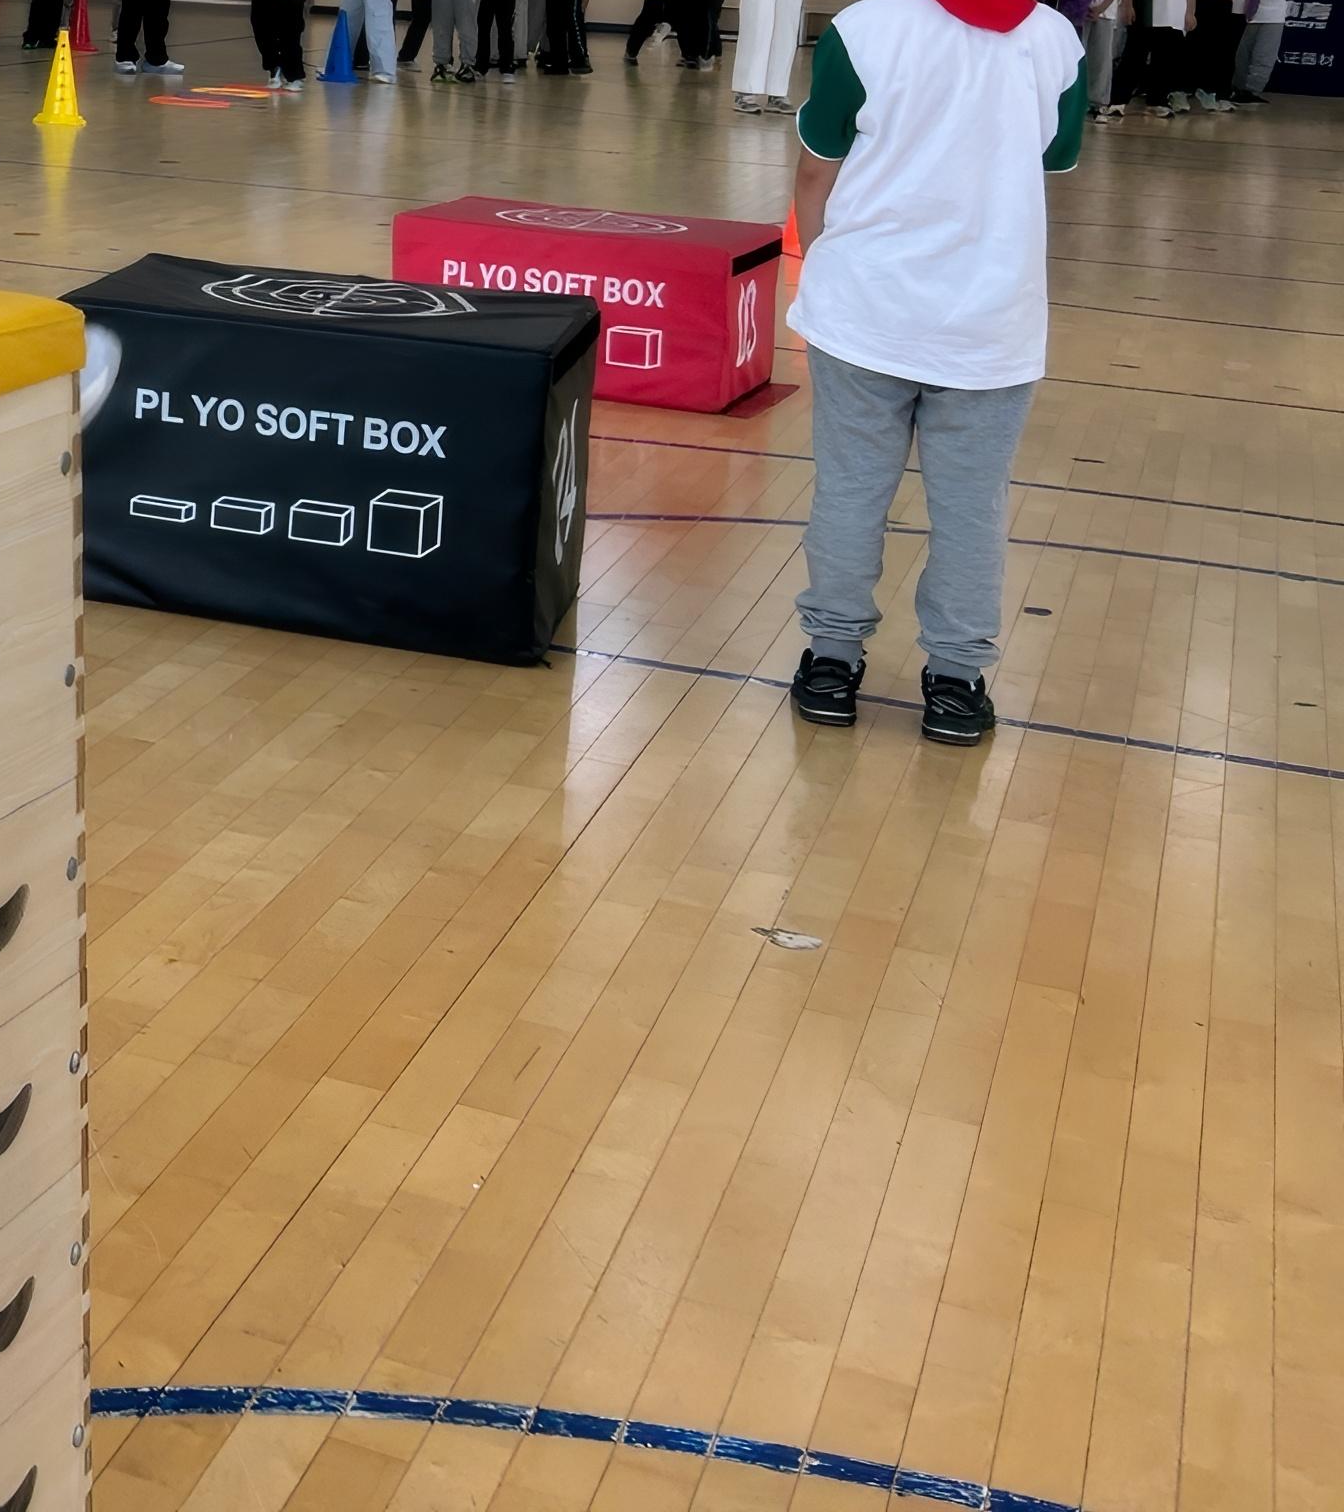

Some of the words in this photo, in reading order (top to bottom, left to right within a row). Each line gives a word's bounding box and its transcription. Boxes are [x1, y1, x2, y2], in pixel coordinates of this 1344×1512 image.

[479, 263, 517, 291] YO
[524, 267, 597, 296] SOFT
[603, 276, 666, 308] BOX
[191, 394, 245, 431] YO
[255, 403, 354, 445] SOFT
[363, 417, 447, 458] BOX
